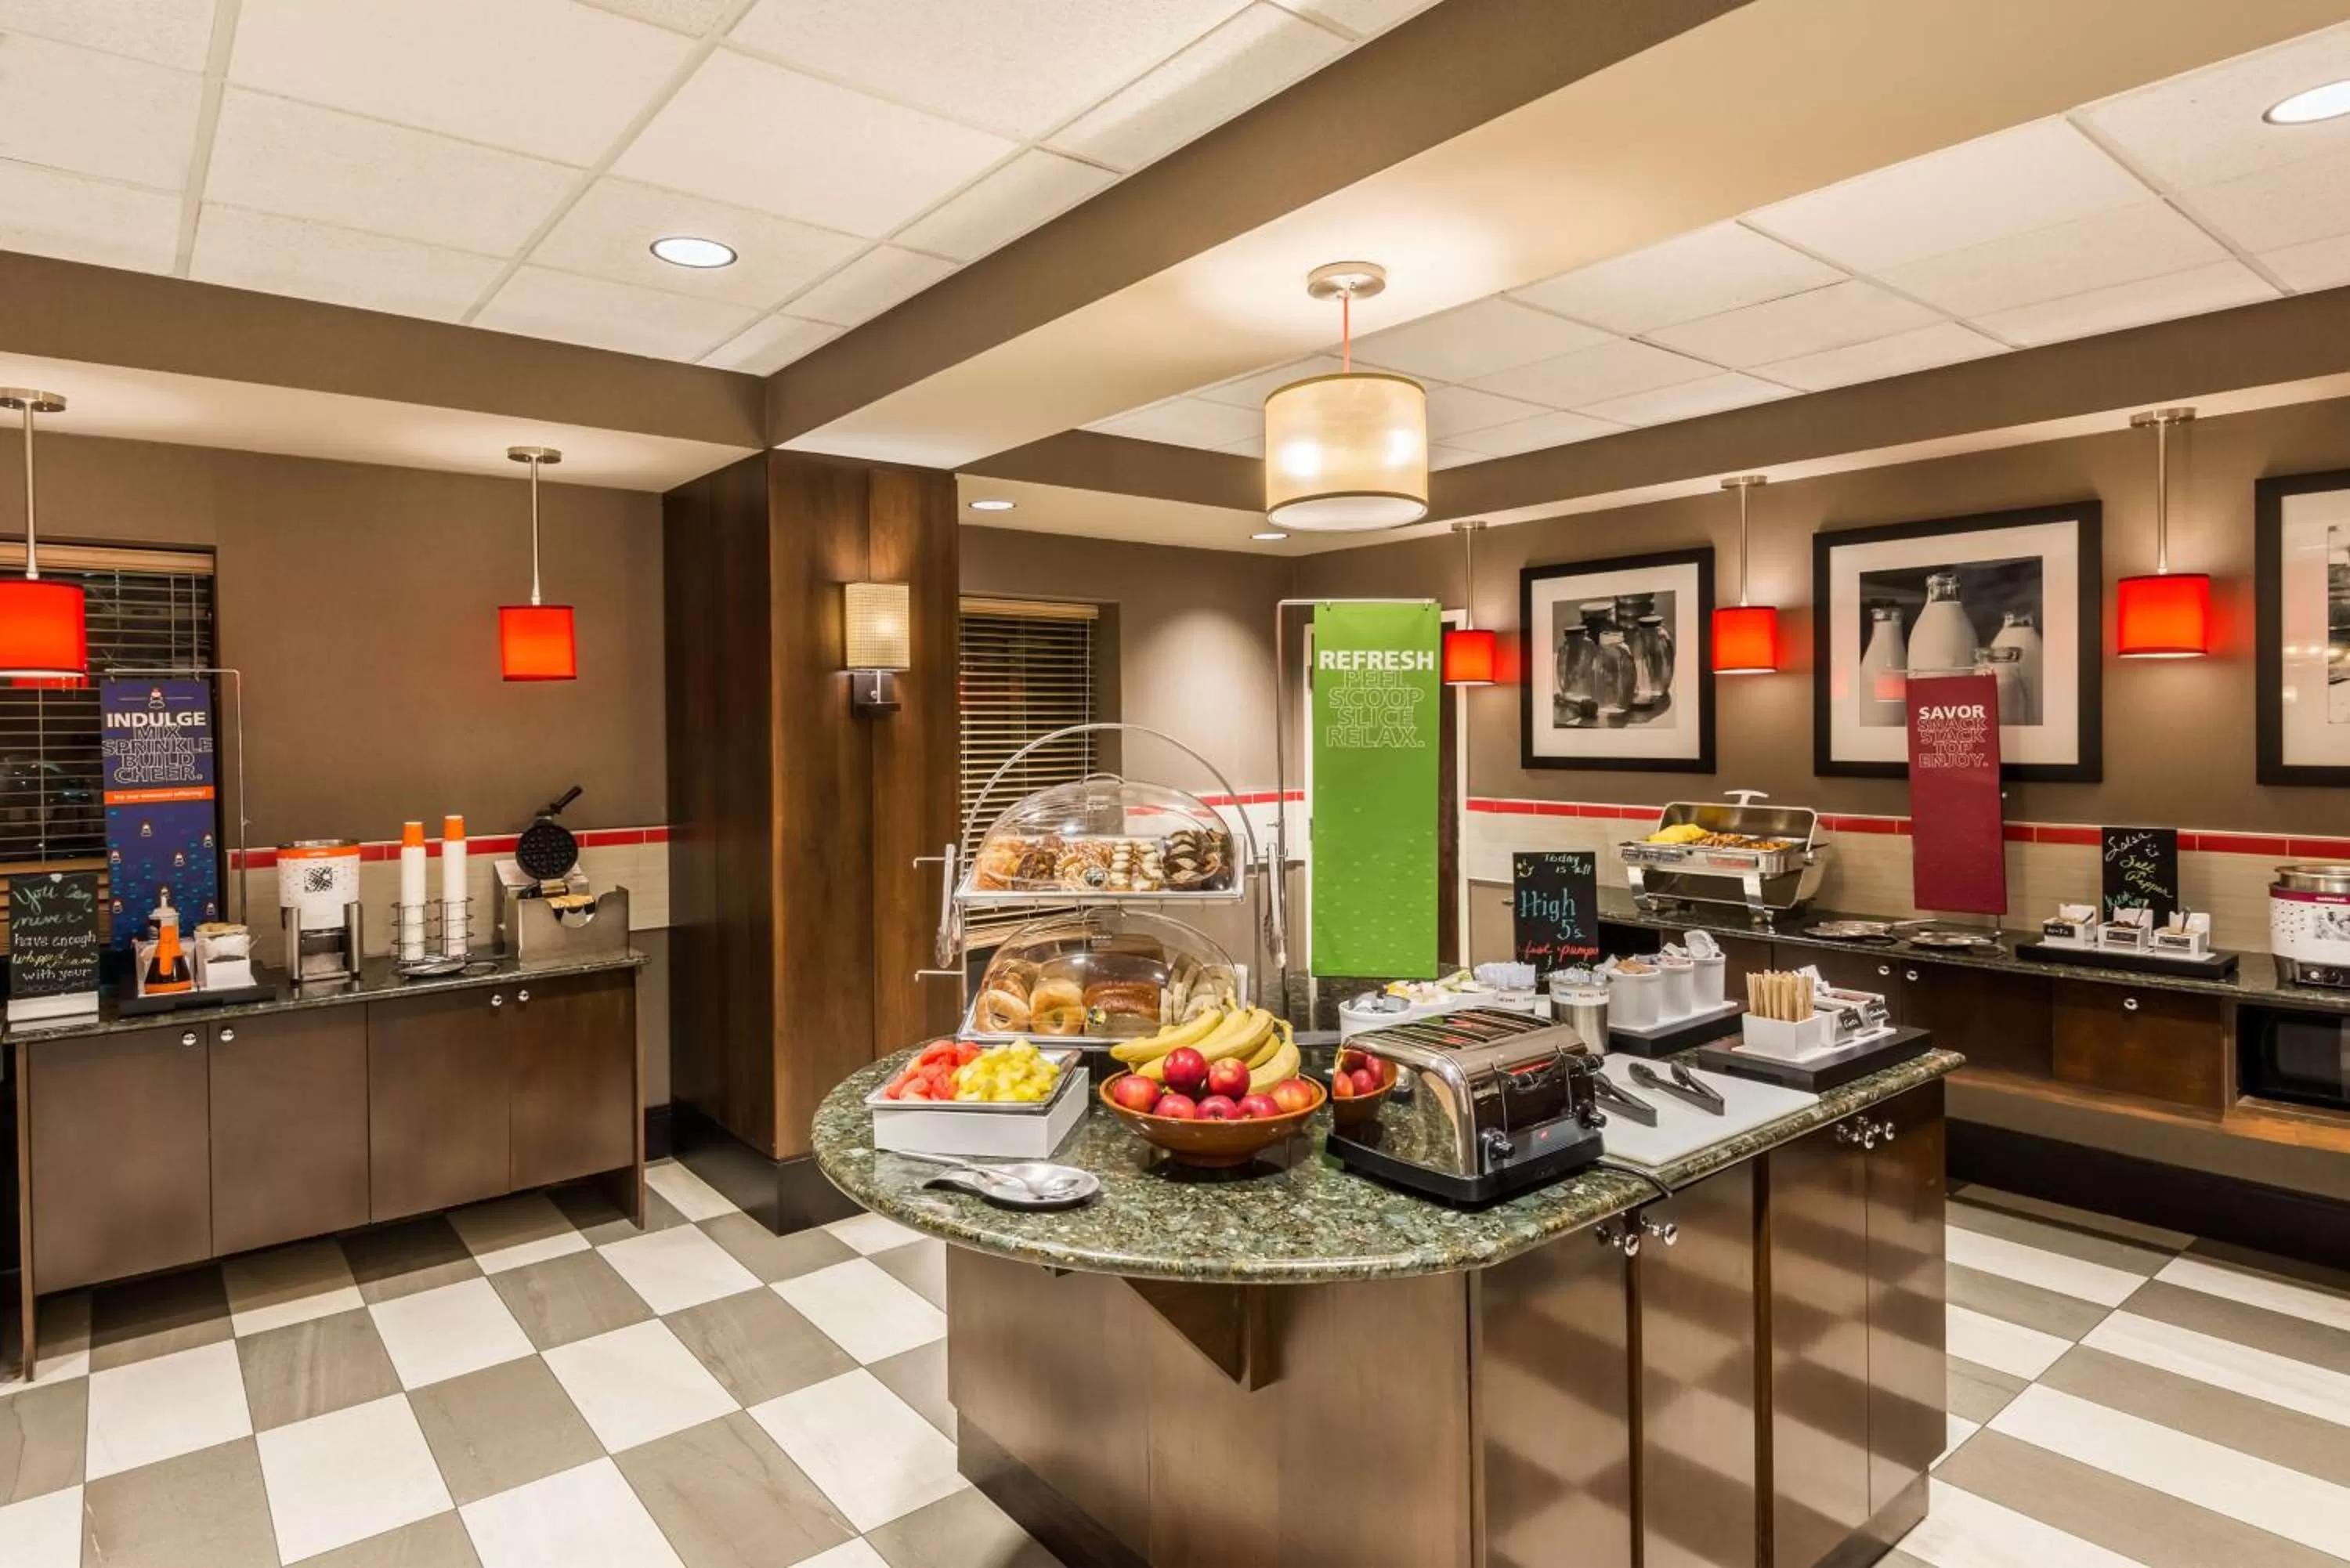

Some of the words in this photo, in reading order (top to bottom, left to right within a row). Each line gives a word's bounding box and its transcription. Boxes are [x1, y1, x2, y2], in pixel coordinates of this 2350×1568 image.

[1319, 651, 1434, 671] REFRESH
[1328, 687, 1426, 709] SCOOP
[107, 712, 207, 728] INDULGE
[1337, 706, 1415, 728] SLICE
[1918, 705, 1986, 720] SAVOR
[133, 725, 181, 740] MIX
[1918, 718, 1987, 732] SNACK
[1326, 726, 1426, 748] RELAX.
[1919, 730, 1987, 744] STACK
[102, 738, 213, 757] SPRINKLE
[121, 752, 195, 768] BUILD
[1520, 887, 1576, 923] High
[15, 933, 49, 947] have
[51, 930, 96, 948] enough
[22, 969, 56, 981] with
[58, 969, 92, 981] your
